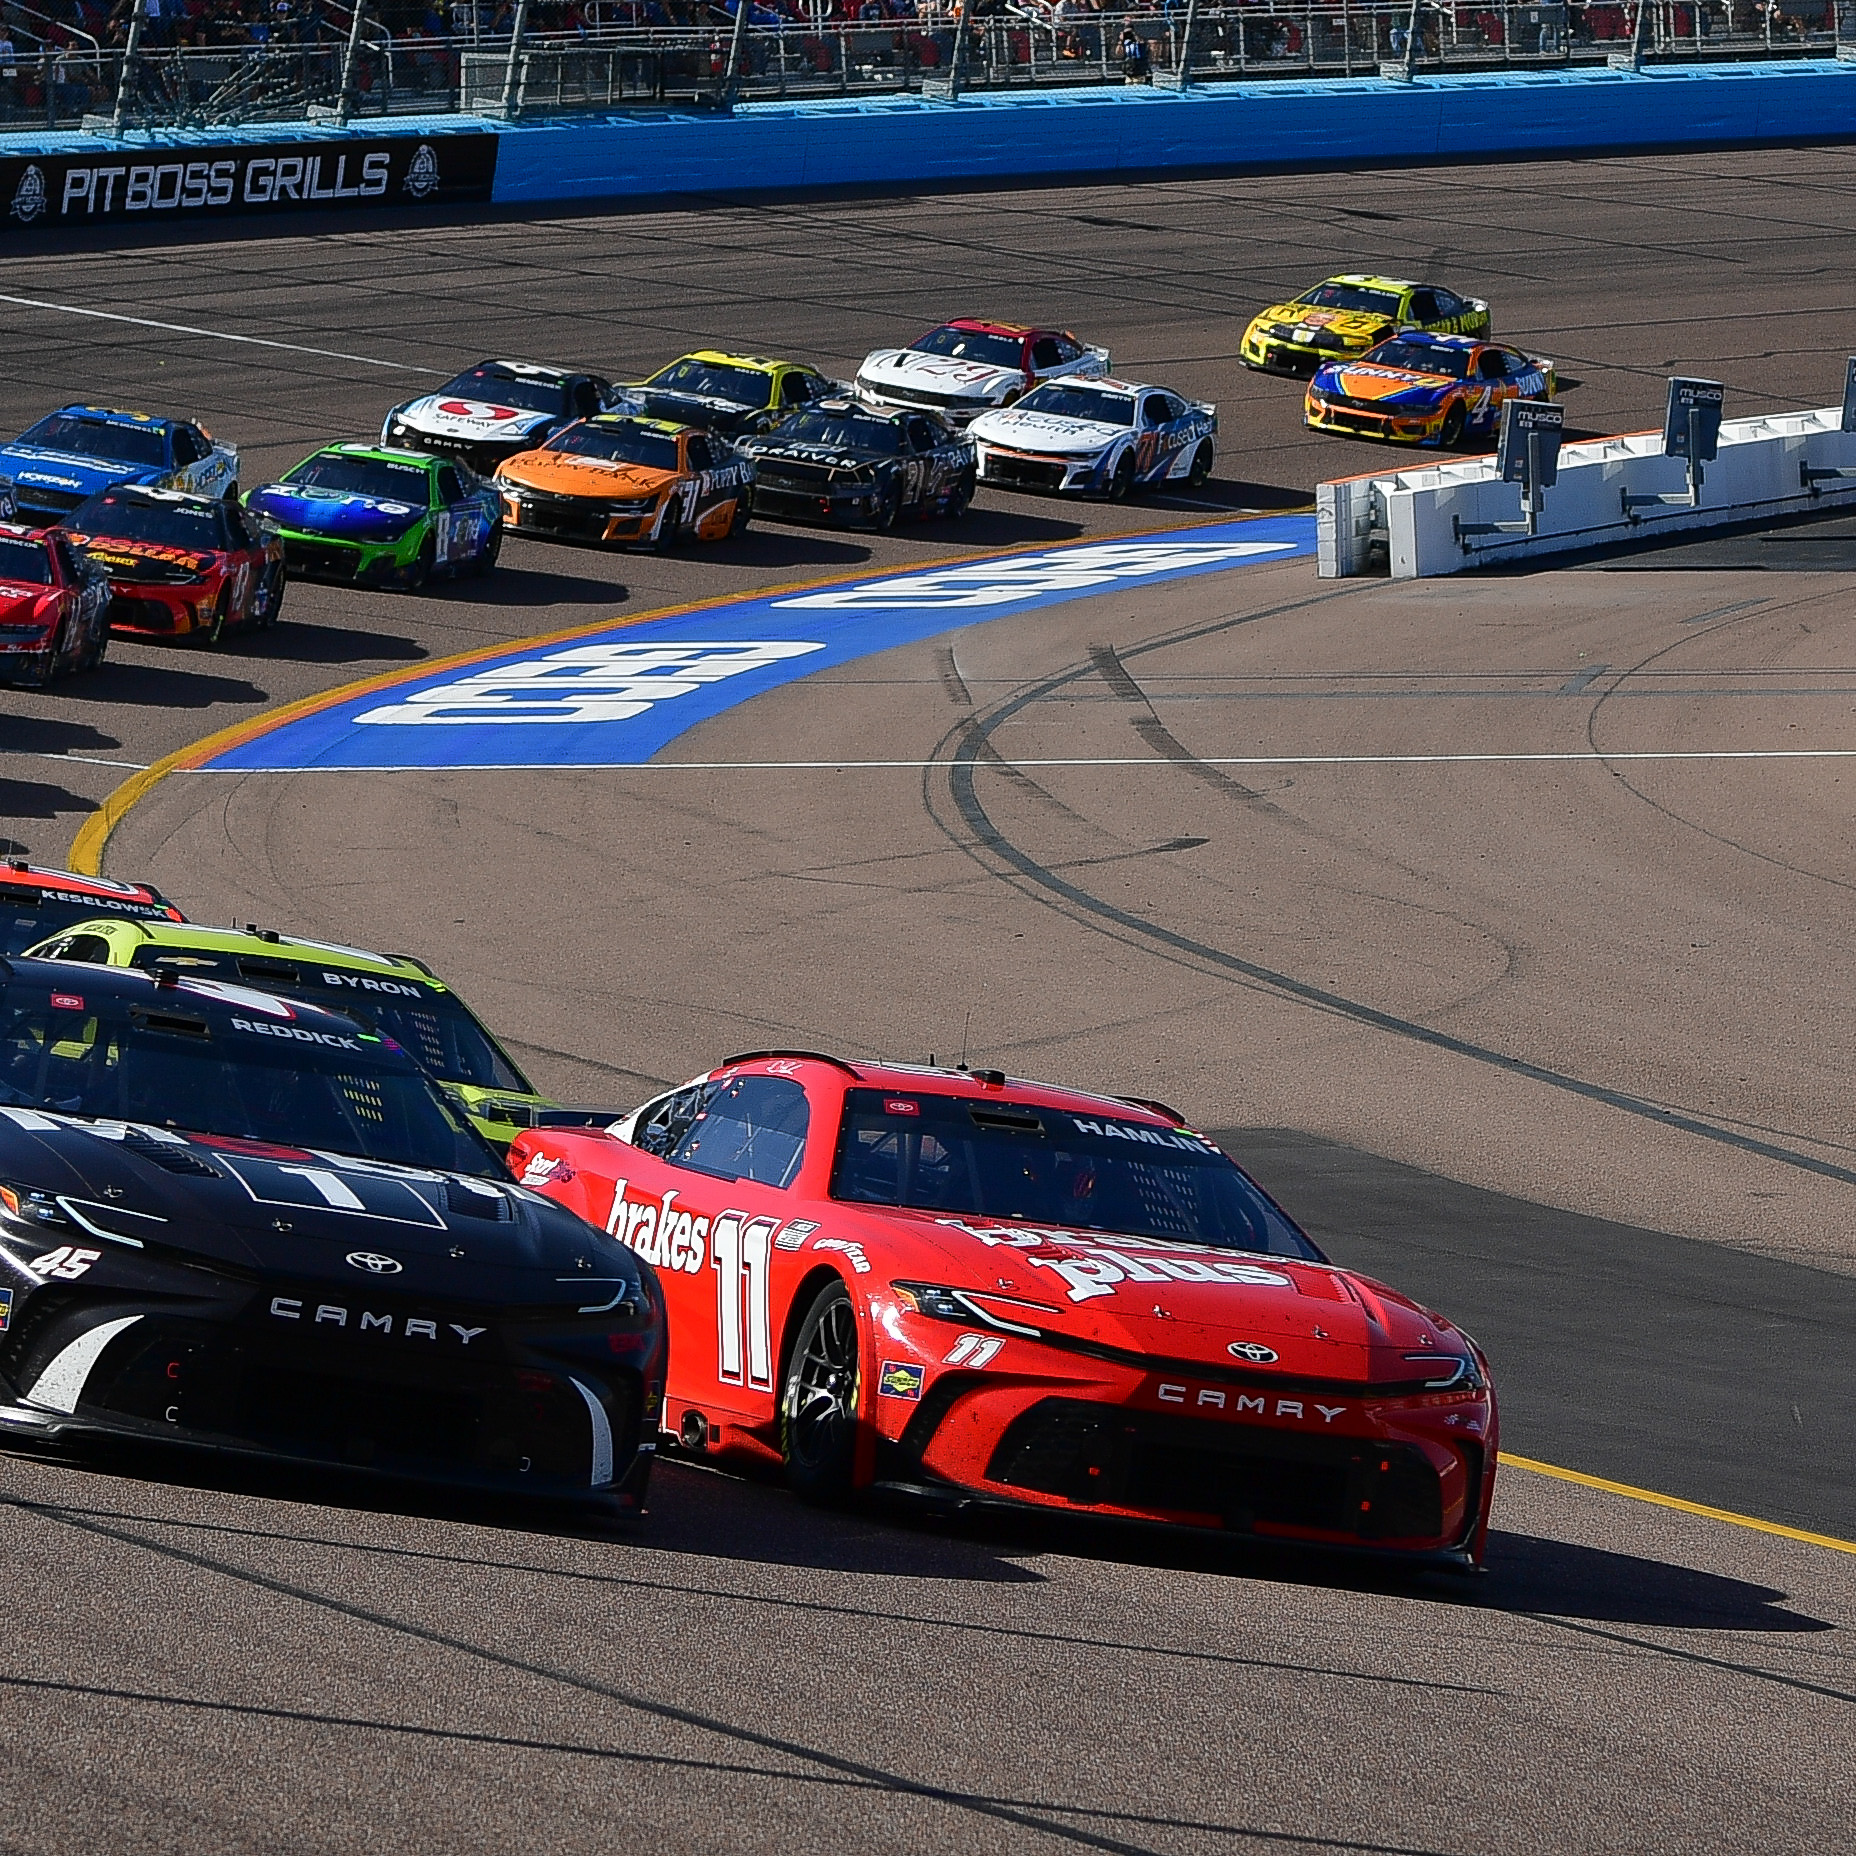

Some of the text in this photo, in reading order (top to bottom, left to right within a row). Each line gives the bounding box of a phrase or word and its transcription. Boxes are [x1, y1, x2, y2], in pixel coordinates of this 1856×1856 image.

[244, 151, 391, 204] GRILLS
[1470, 385, 1492, 424] 4
[1680, 387, 1723, 400] musco
[435, 413, 494, 429] SAFEWAY
[1518, 410, 1562, 424] musco
[40, 888, 169, 919] KESELOWSK
[322, 972, 422, 999] BYRON
[230, 1018, 363, 1052] REDDICK
[1072, 1117, 1207, 1154] HAMLIN
[606, 1178, 710, 1276] brakes
[30, 1246, 102, 1279] 45
[1028, 1248, 1292, 1303] plus
[710, 1209, 783, 1393] 11
[270, 1297, 488, 1344] CAMRY
[942, 1333, 1007, 1370] 11
[1156, 1382, 1347, 1424] CAMRY
